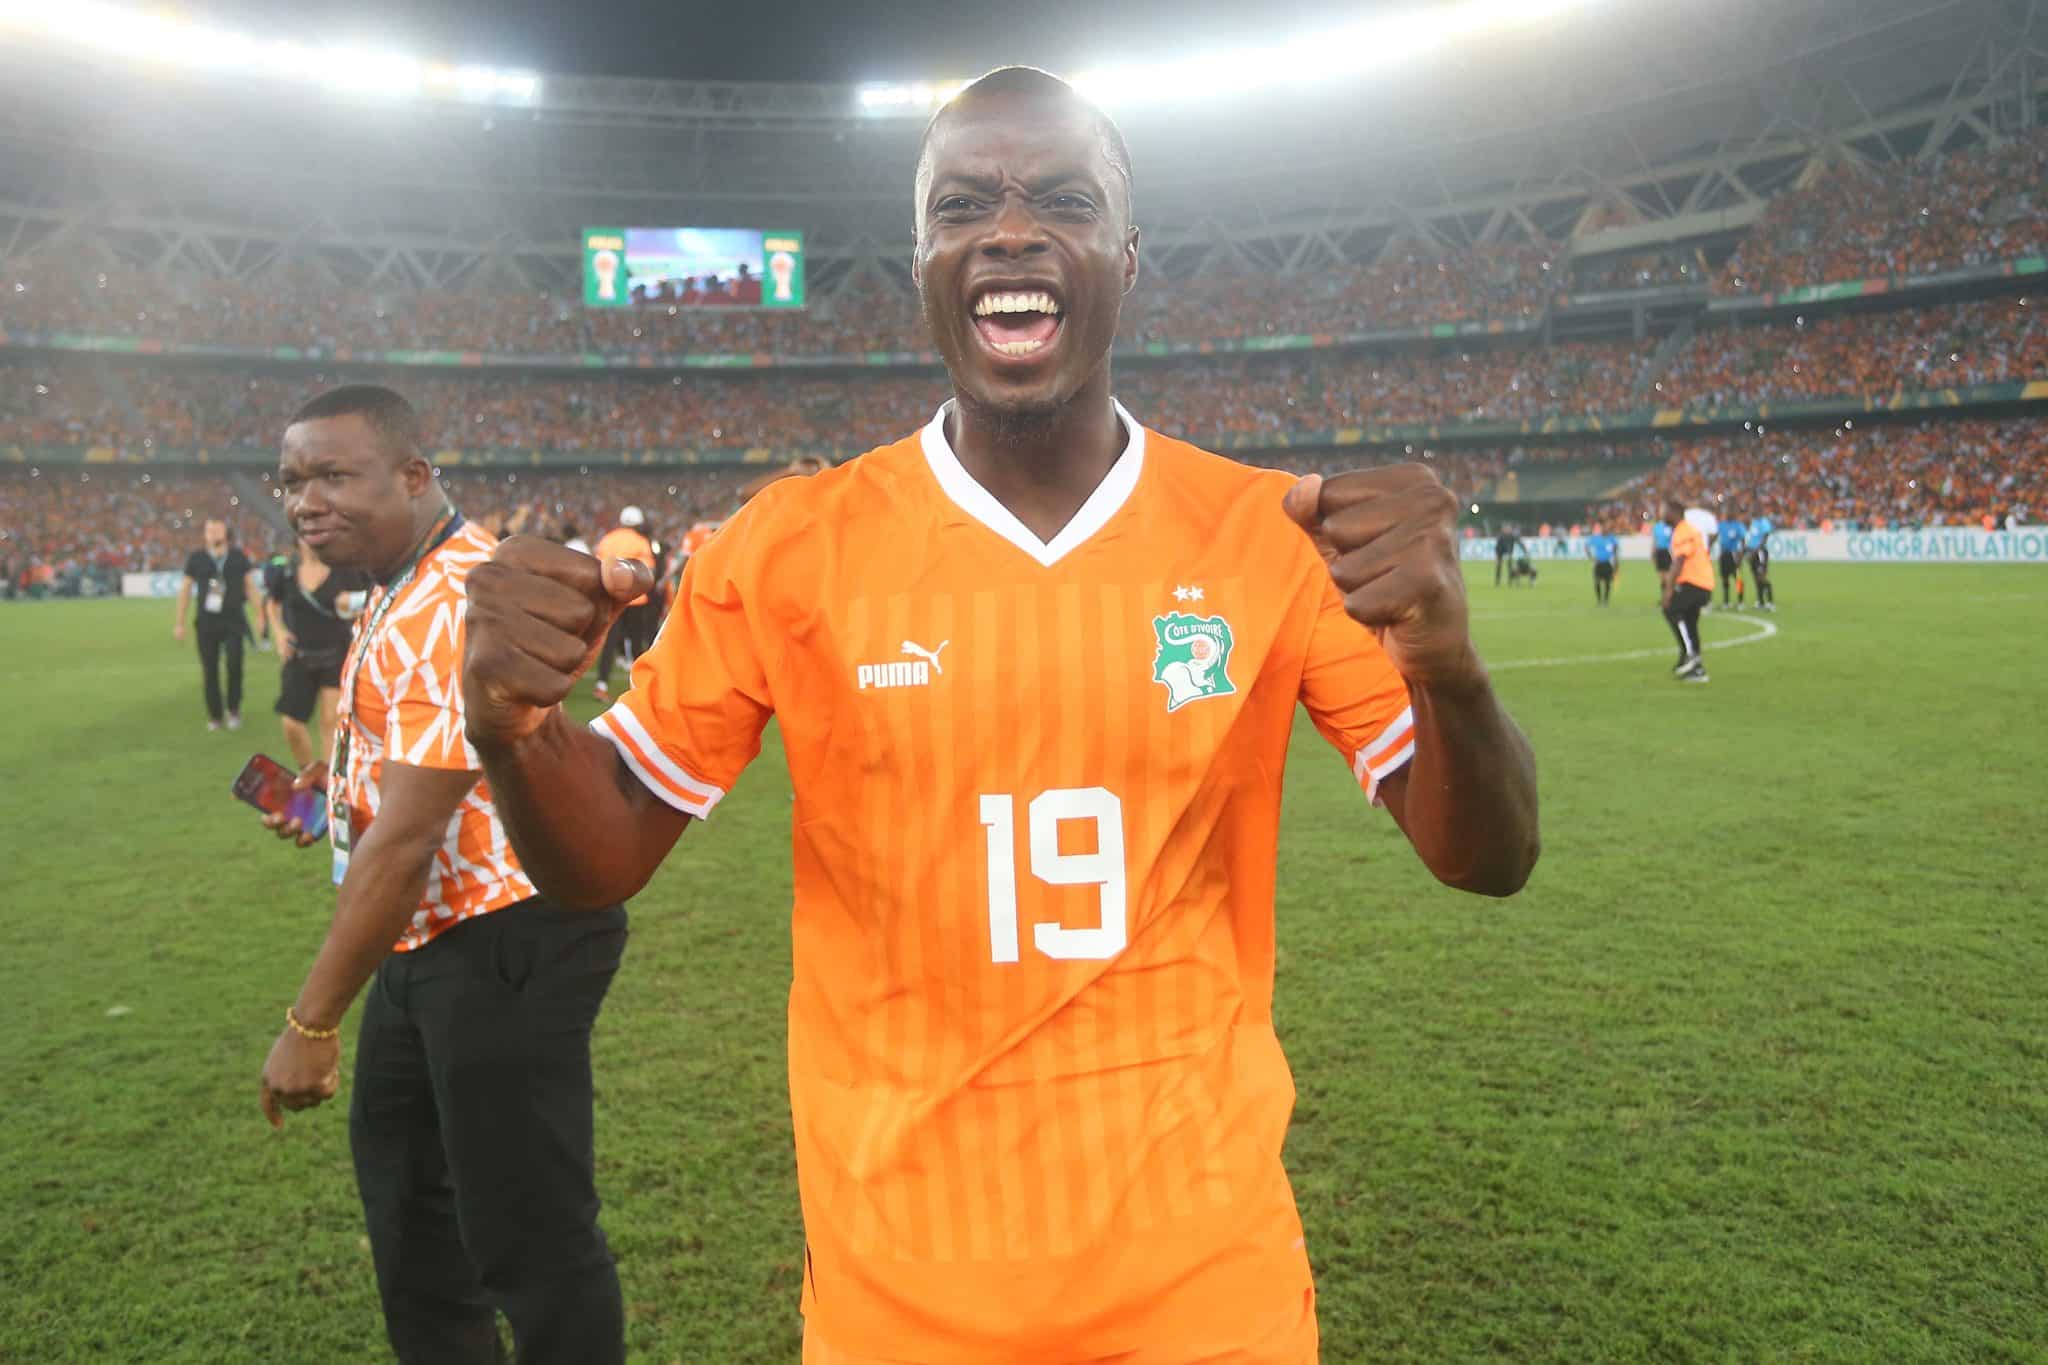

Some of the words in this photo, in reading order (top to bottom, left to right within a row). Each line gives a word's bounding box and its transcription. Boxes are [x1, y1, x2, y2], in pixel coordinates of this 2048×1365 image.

[1847, 533, 2048, 559] CONGRATULATIO
[857, 661, 928, 689] PUMA
[979, 786, 1127, 963] 19
